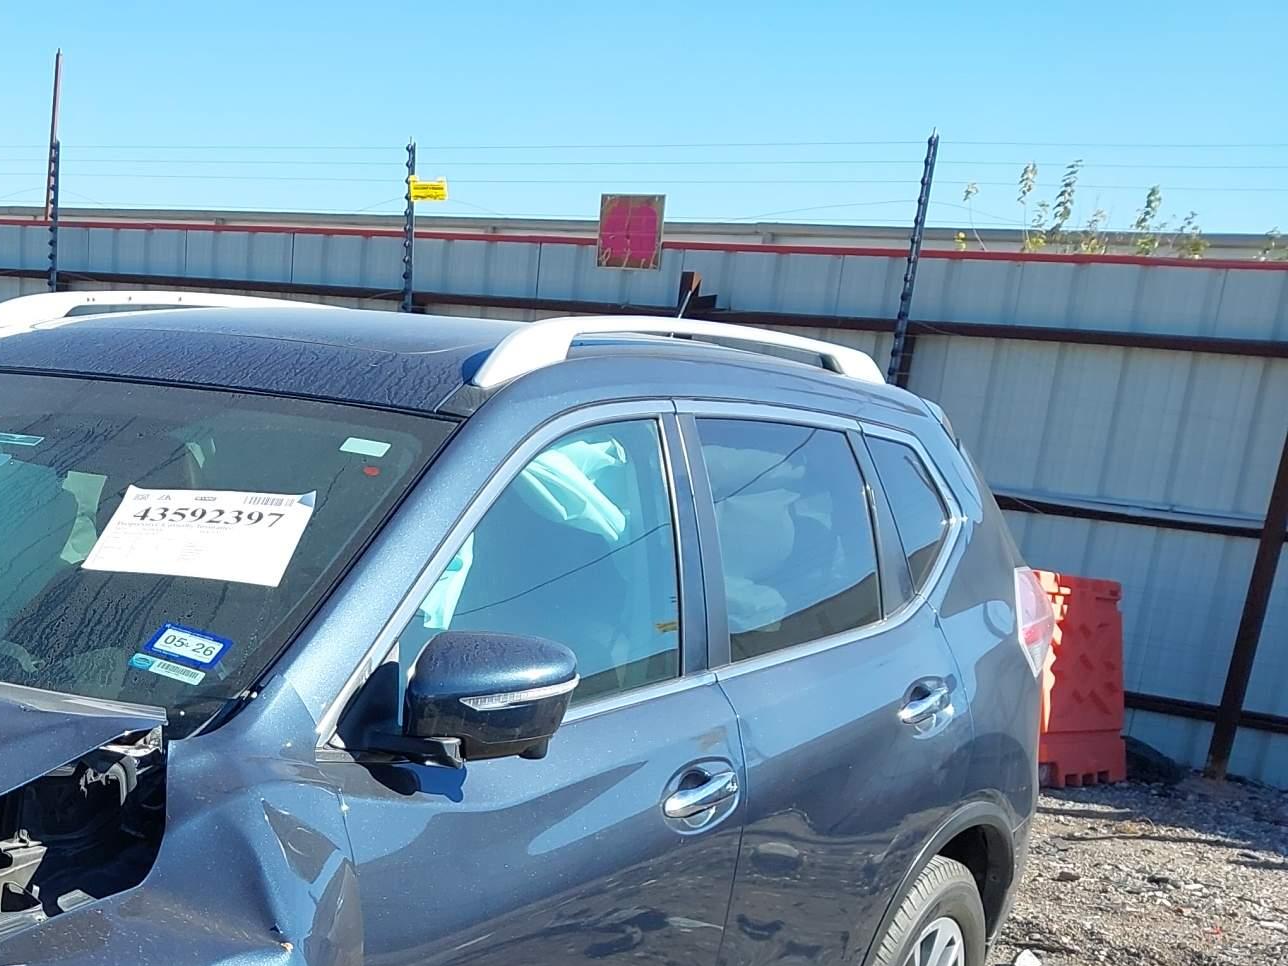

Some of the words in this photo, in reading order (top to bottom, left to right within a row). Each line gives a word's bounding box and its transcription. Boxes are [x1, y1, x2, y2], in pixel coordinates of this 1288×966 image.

[132, 506, 286, 528] 43592397
[163, 634, 188, 648] 05
[192, 642, 216, 657] 26
